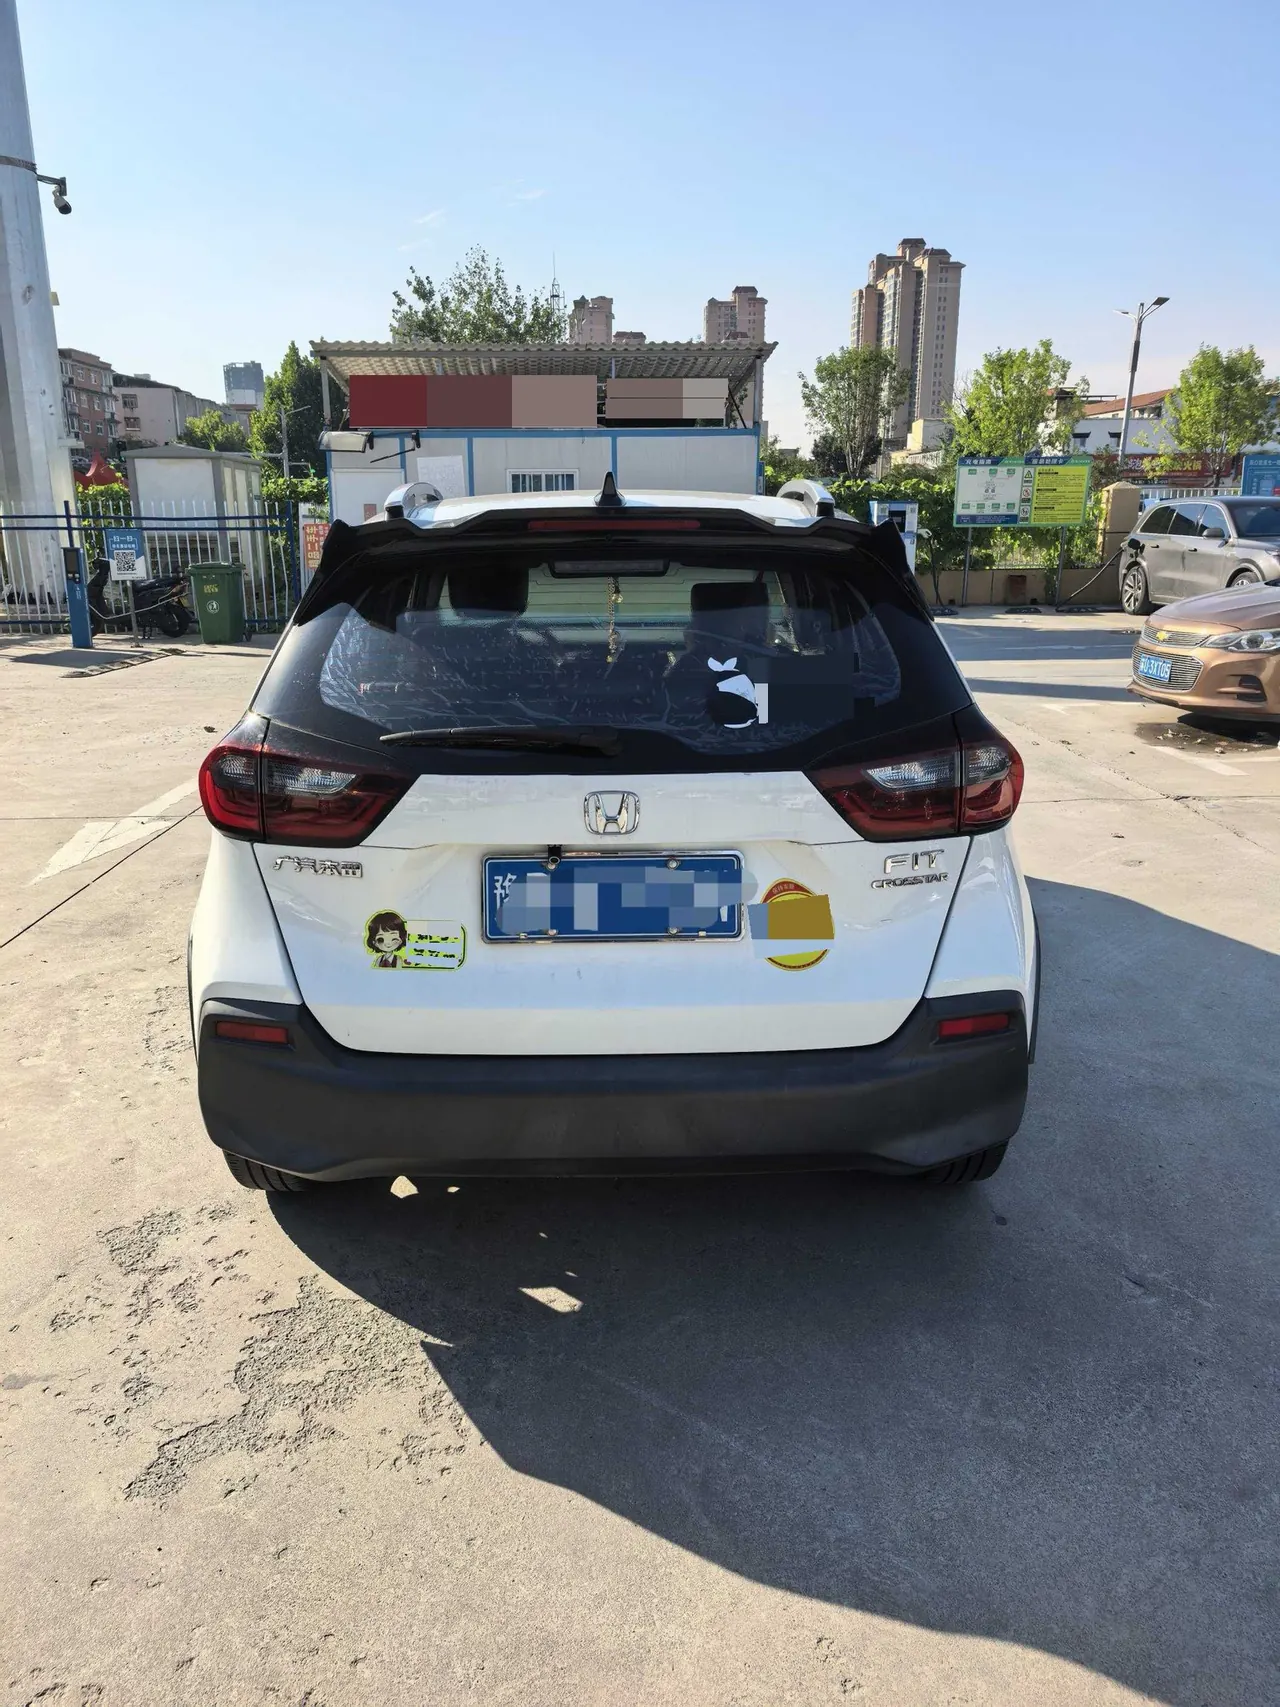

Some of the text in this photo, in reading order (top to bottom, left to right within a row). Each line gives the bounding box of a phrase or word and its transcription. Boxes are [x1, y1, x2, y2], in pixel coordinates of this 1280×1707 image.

[273, 855, 362, 878] 广汽本田
[884, 849, 945, 874] FIT
[871, 872, 949, 889] CROSSTAR
